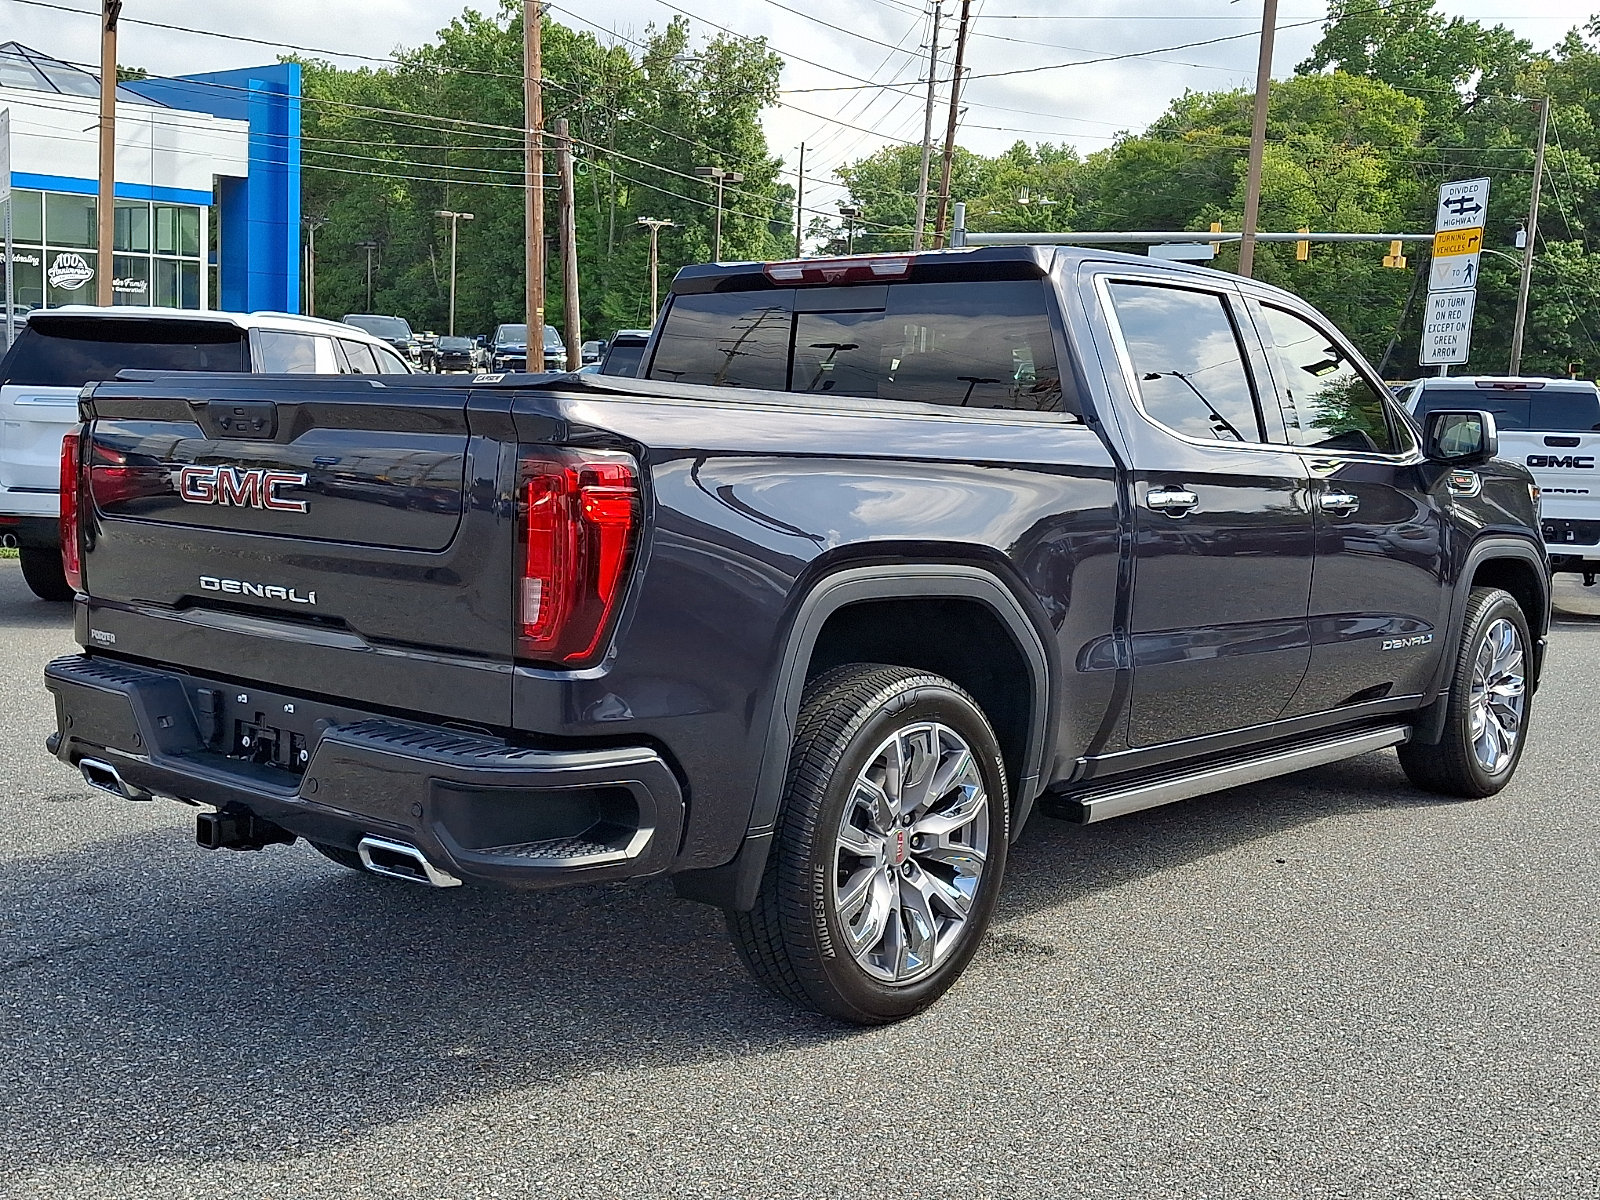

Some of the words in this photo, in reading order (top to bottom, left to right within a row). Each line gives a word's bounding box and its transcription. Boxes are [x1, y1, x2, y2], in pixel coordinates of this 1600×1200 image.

[1449, 185, 1479, 196] DIVIDED
[1443, 215, 1478, 227] HIGHWAY
[1438, 233, 1466, 244] TURNING
[1436, 244, 1466, 254] VEHICLES
[57, 253, 79, 267] 100
[50, 266, 93, 277] Anniversary
[1452, 269, 1461, 277] TO
[124, 277, 147, 290] Family
[1435, 298, 1445, 309] NO
[1447, 297, 1466, 308] TURN
[1435, 311, 1446, 321] ON
[1447, 310, 1462, 320] RED
[1428, 323, 1455, 333] EXCEPT
[1456, 322, 1466, 332] ON
[1434, 335, 1458, 345] GREEN
[1432, 348, 1457, 358] ARROW
[1526, 454, 1595, 469] GMC
[180, 465, 312, 515] GMC
[199, 575, 317, 606] DENALI
[91, 628, 116, 644] PORTER
[1381, 634, 1433, 651] DENALI
[995, 755, 1010, 840] BRIDGESTONE
[812, 862, 837, 960] BRIDGESTONE
